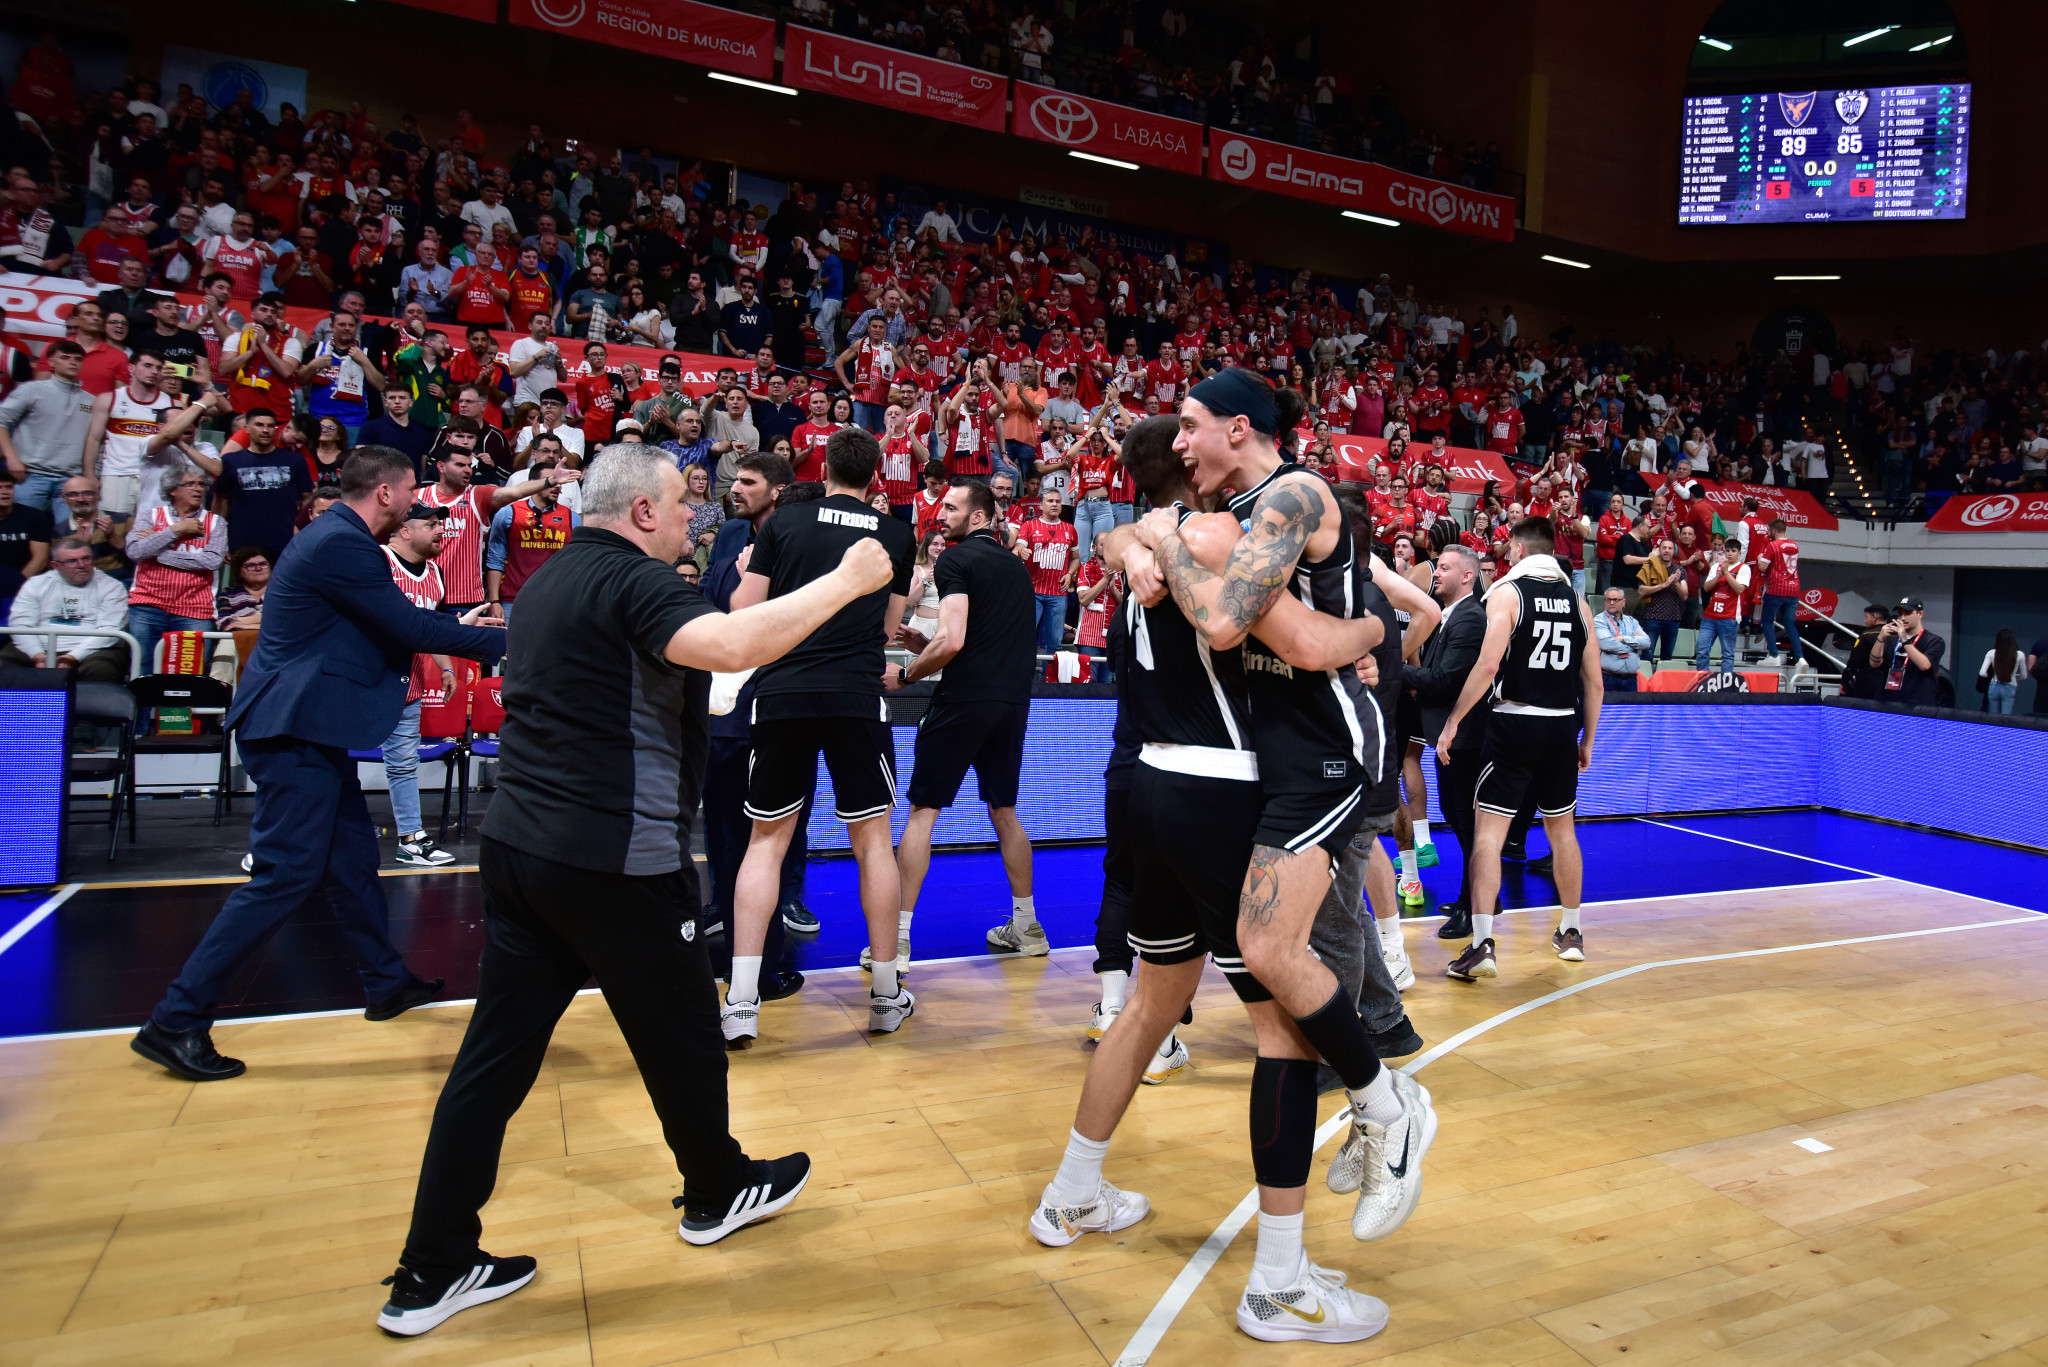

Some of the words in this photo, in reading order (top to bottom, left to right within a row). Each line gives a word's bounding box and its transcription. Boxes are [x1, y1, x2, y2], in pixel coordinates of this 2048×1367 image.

[597, 11, 662, 38] REGIÓN
[667, 26, 689, 43] DE
[694, 32, 757, 58] MURCIA
[927, 85, 938, 95] Tu
[940, 89, 964, 99] socio
[1114, 122, 1187, 155] LABASA
[1774, 128, 1792, 136] UCAM
[1782, 137, 1806, 156] 89
[1837, 135, 1862, 154] 85
[1265, 153, 1363, 196] dama
[1804, 161, 1837, 176] 0.0
[1775, 185, 1781, 195] 5
[1816, 187, 1823, 197] 4
[1859, 182, 1866, 192] 5
[1388, 181, 1500, 228] CROWN
[218, 254, 254, 266] UCAM
[739, 314, 758, 325] SW
[1053, 476, 1065, 488] 13
[1742, 484, 1784, 496] Hospital
[817, 507, 879, 531] IATRIDIS
[1776, 511, 1808, 525] Murcia
[520, 528, 566, 543] UCAM
[1534, 598, 1571, 614] FILLIOS
[1713, 602, 1725, 613] 15
[1528, 620, 1572, 671] 25
